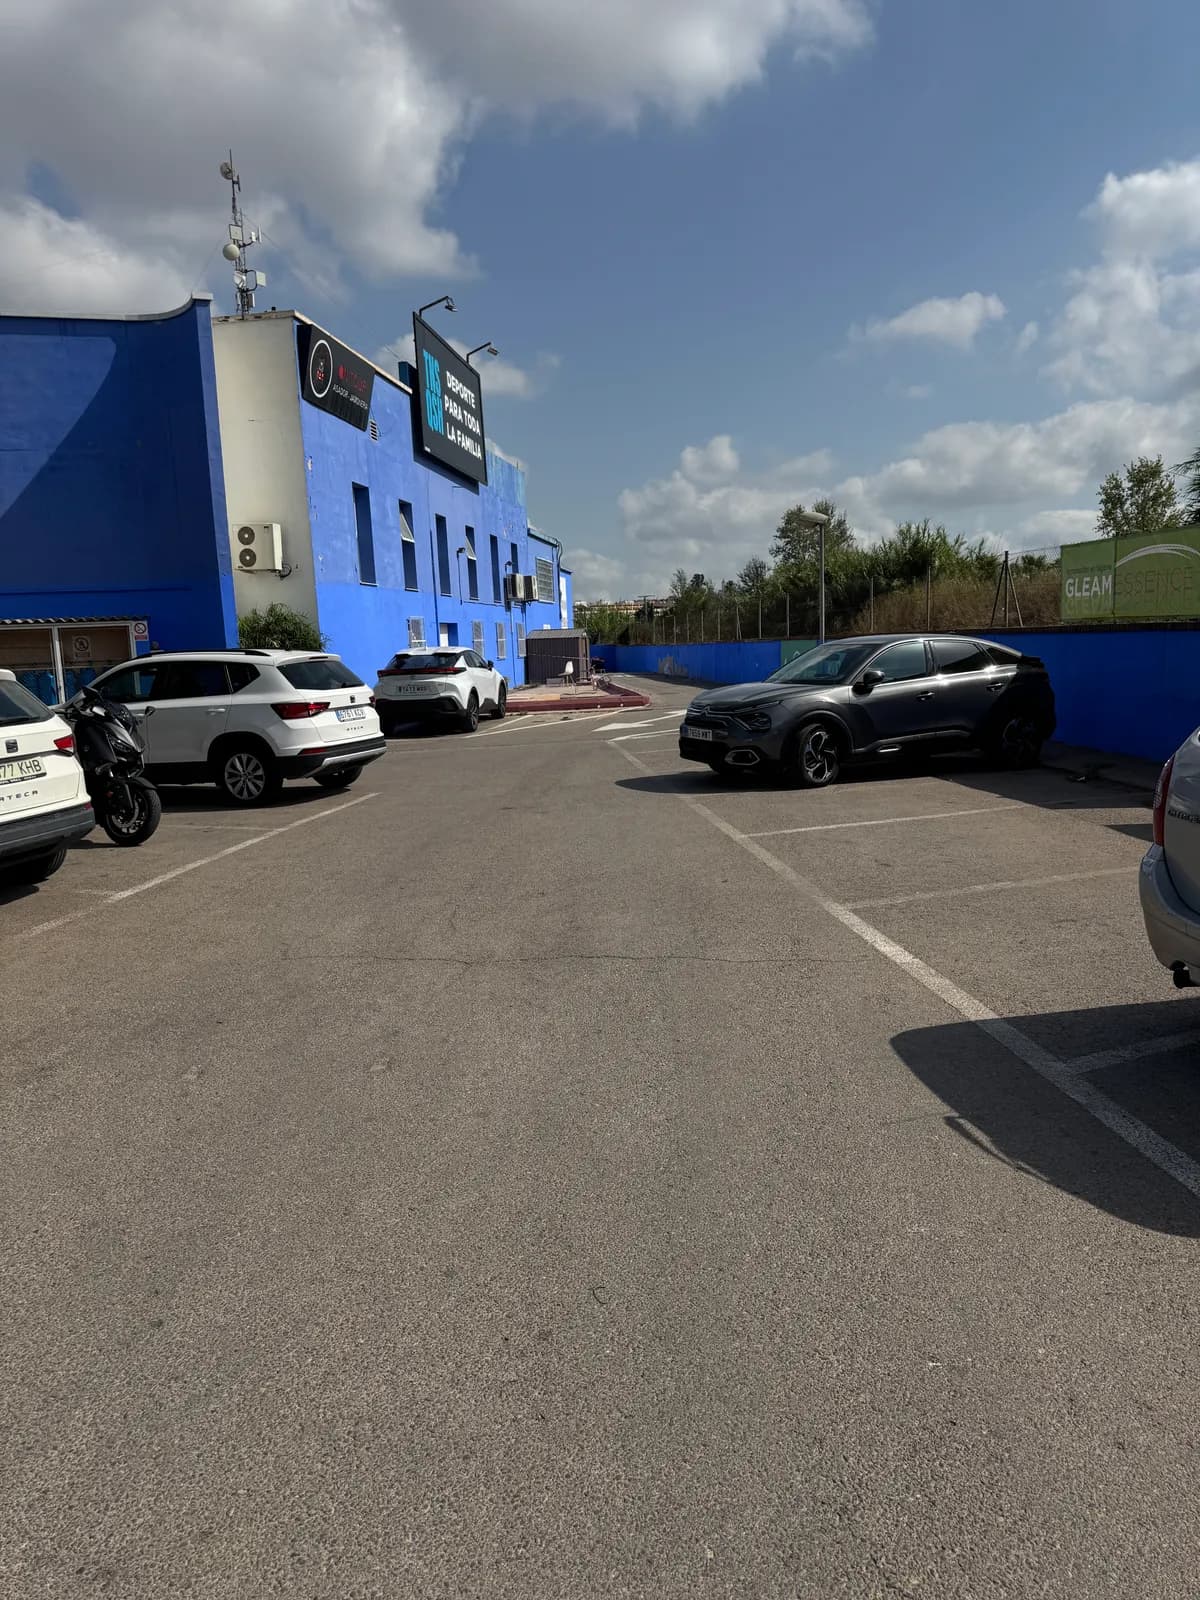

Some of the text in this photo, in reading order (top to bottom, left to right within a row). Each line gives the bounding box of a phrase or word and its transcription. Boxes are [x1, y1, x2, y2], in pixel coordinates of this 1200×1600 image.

[446, 370, 475, 409] DEPORTE
[444, 394, 481, 436] PARA TODA
[446, 422, 482, 460] LA FAMILIA
[1065, 575, 1112, 598] GLEAM
[17, 759, 42, 775] KHB
